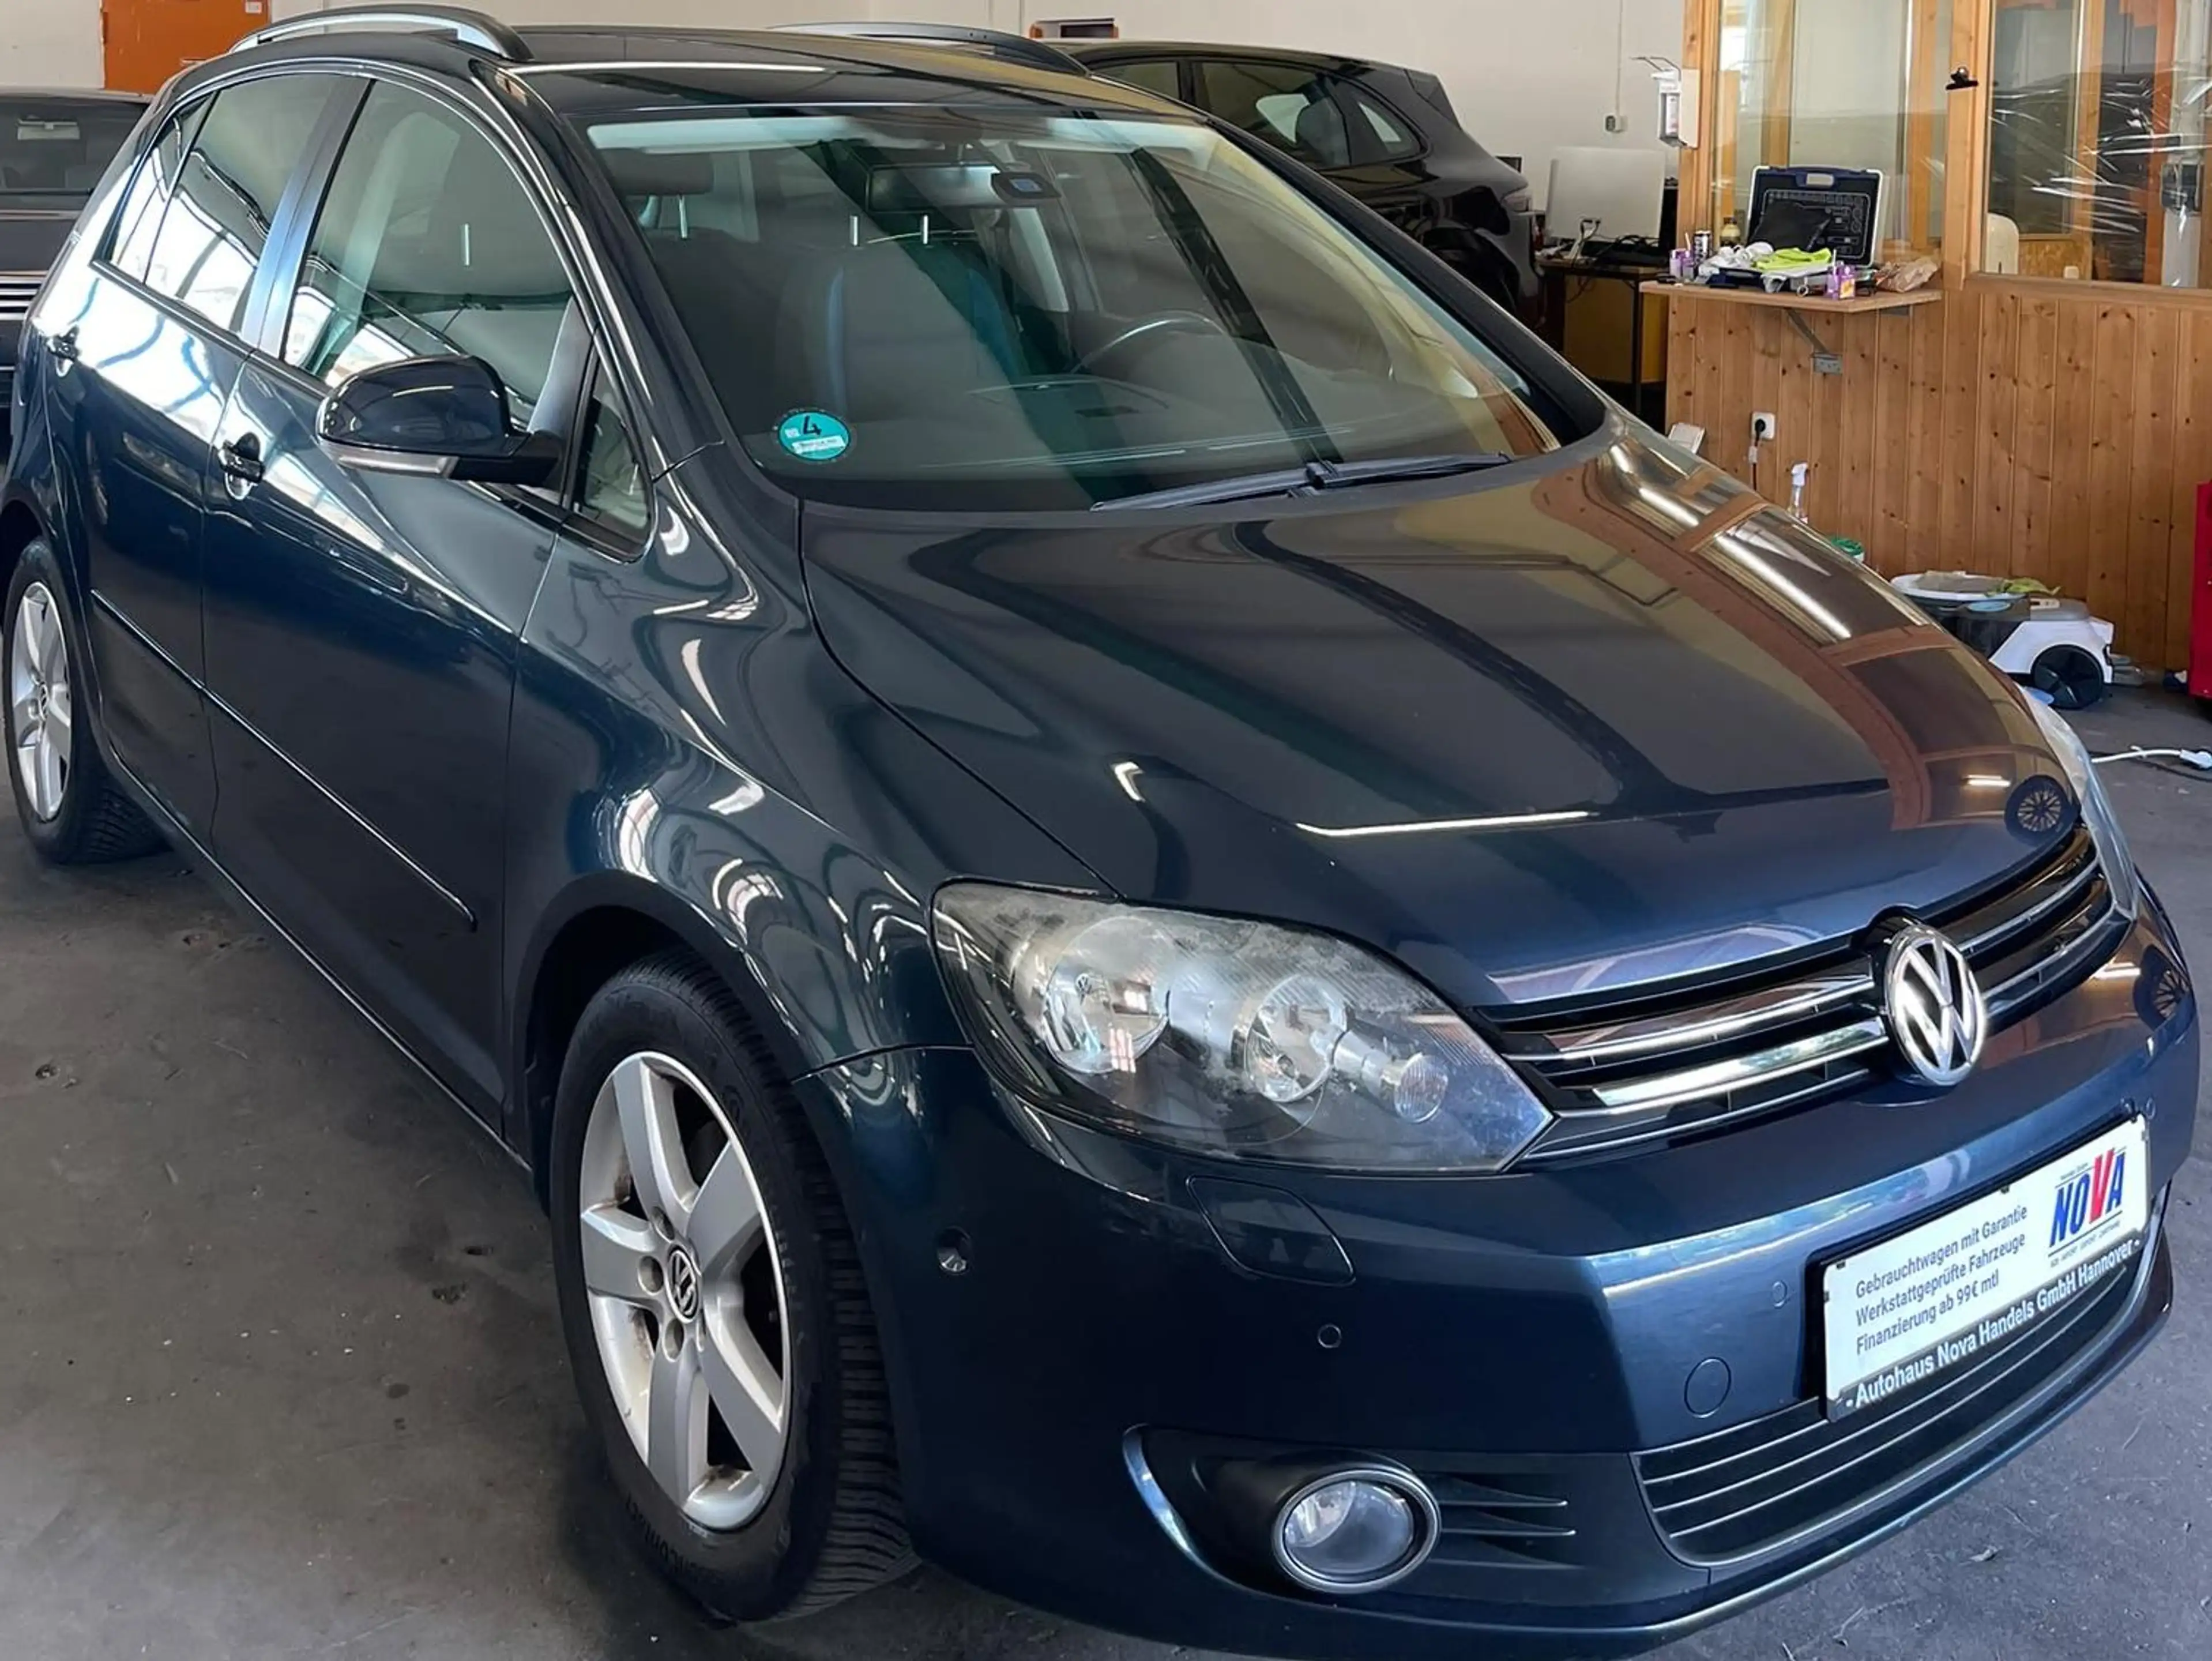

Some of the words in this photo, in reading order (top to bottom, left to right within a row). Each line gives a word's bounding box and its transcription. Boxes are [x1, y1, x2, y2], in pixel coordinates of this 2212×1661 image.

[803, 416, 822, 435] 4
[2049, 1147, 2126, 1248] NOVA
[1856, 1241, 1959, 1299] Gebrauchtwagen
[1961, 1227, 1980, 1250] mit
[1982, 1205, 2027, 1239] Garantie
[1856, 1262, 1966, 1327] Werkstattgeprüfte
[1969, 1234, 2025, 1273] Fahrzeuge
[1855, 1355, 1934, 1409] Autohaus
[1936, 1333, 1977, 1369] Nova
[1978, 1300, 2035, 1346] Handels
[2037, 1271, 2076, 1311] GmbH
[2078, 1239, 2133, 1287] Hannover
[1856, 1305, 1936, 1355] Finanzierung
[1939, 1293, 1954, 1315] ab
[1956, 1280, 1978, 1306] 99€
[1981, 1268, 1999, 1294] mtl
